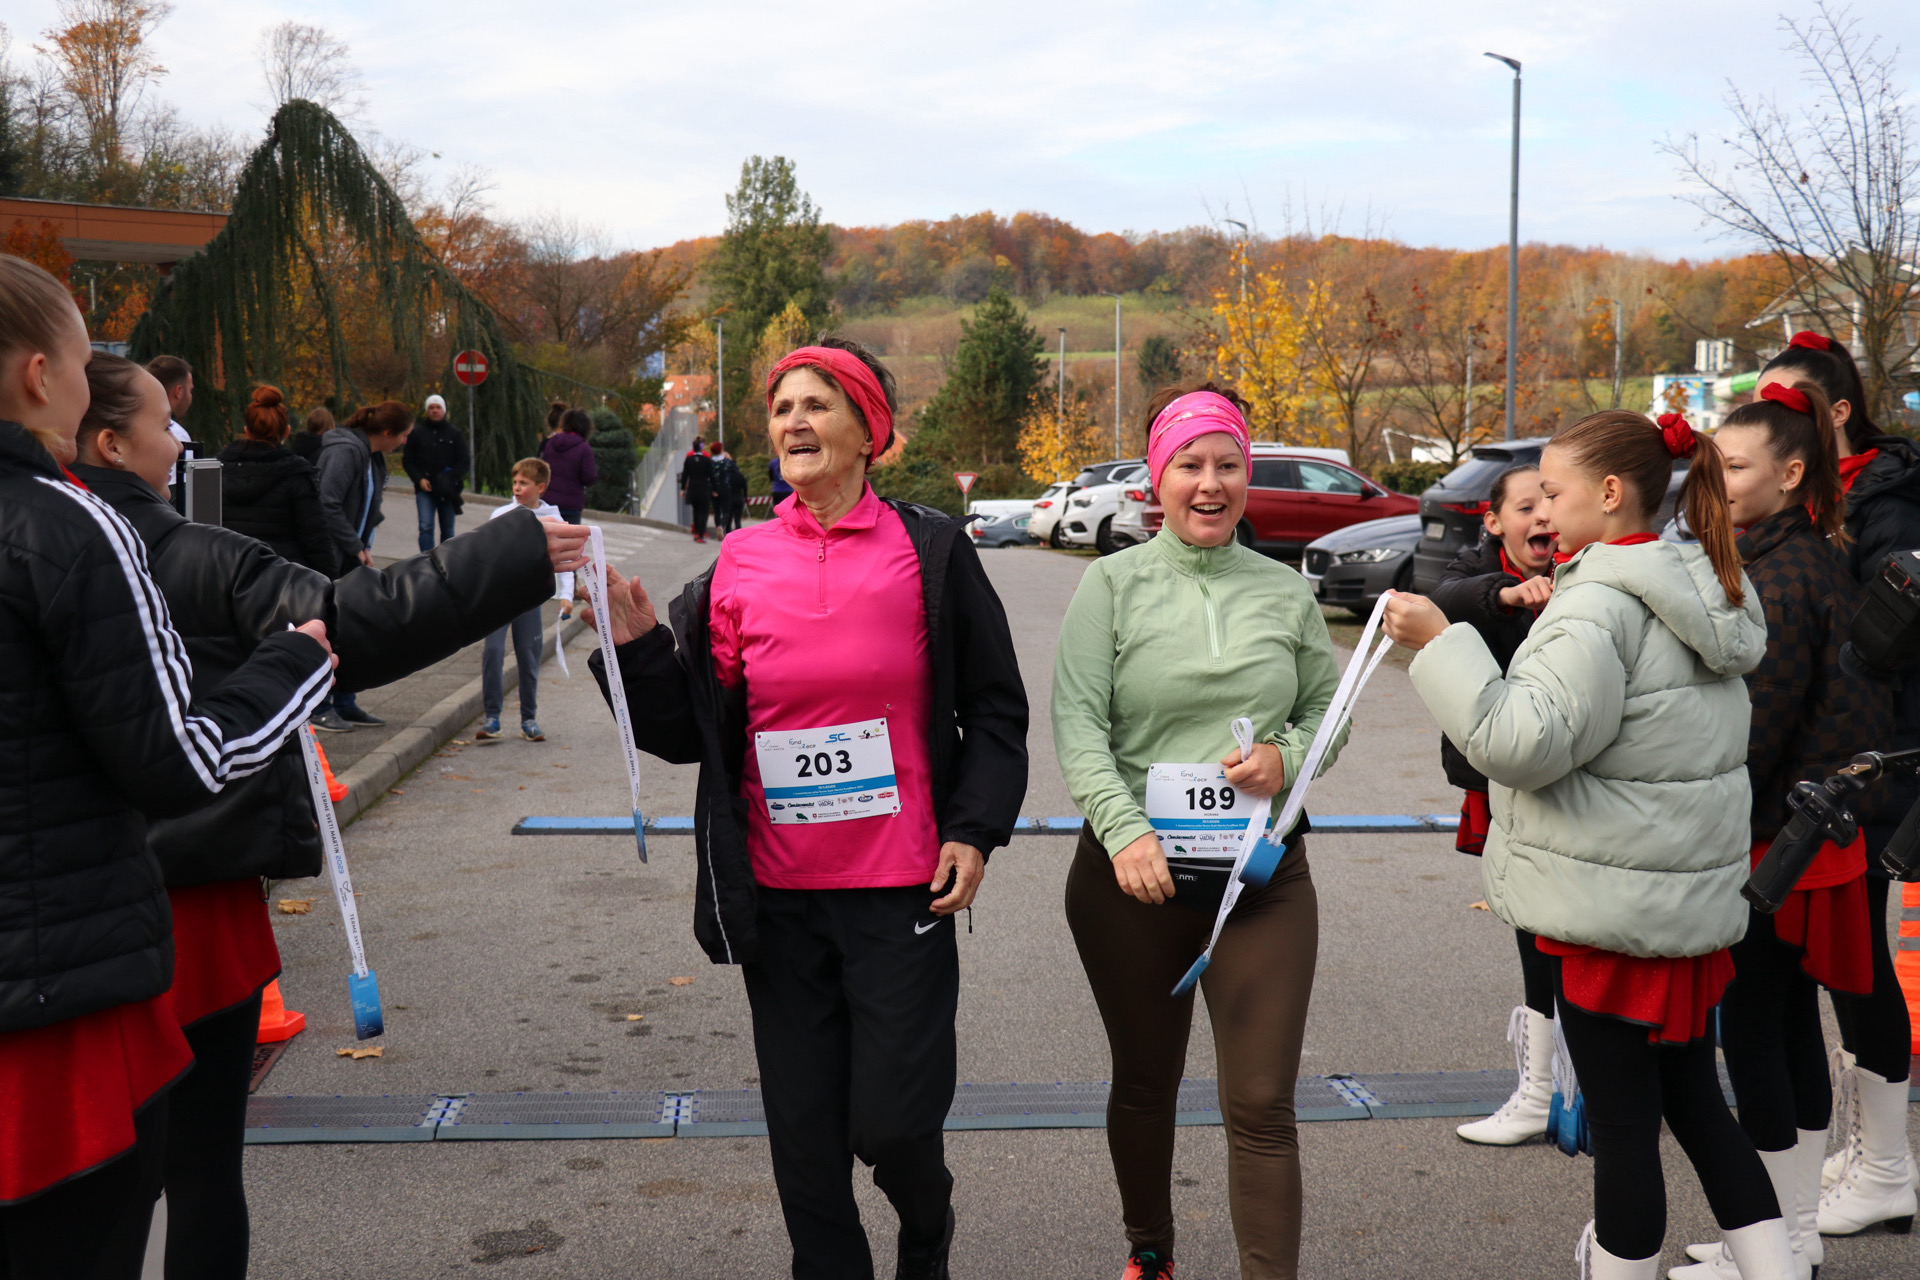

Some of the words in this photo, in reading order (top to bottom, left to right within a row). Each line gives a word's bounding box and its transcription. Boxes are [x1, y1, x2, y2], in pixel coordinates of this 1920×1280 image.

[597, 607, 605, 624] 2023
[601, 624, 610, 645] MARTIN
[825, 732, 851, 744] SC
[795, 749, 853, 778] 203
[320, 791, 330, 812] TERME
[1185, 786, 1235, 810] 189
[325, 812, 335, 830] SVETI
[329, 829, 340, 855] MARTIN
[334, 855, 345, 875] 2023
[350, 913, 358, 934] TERME
[353, 934, 362, 952] SVETI
